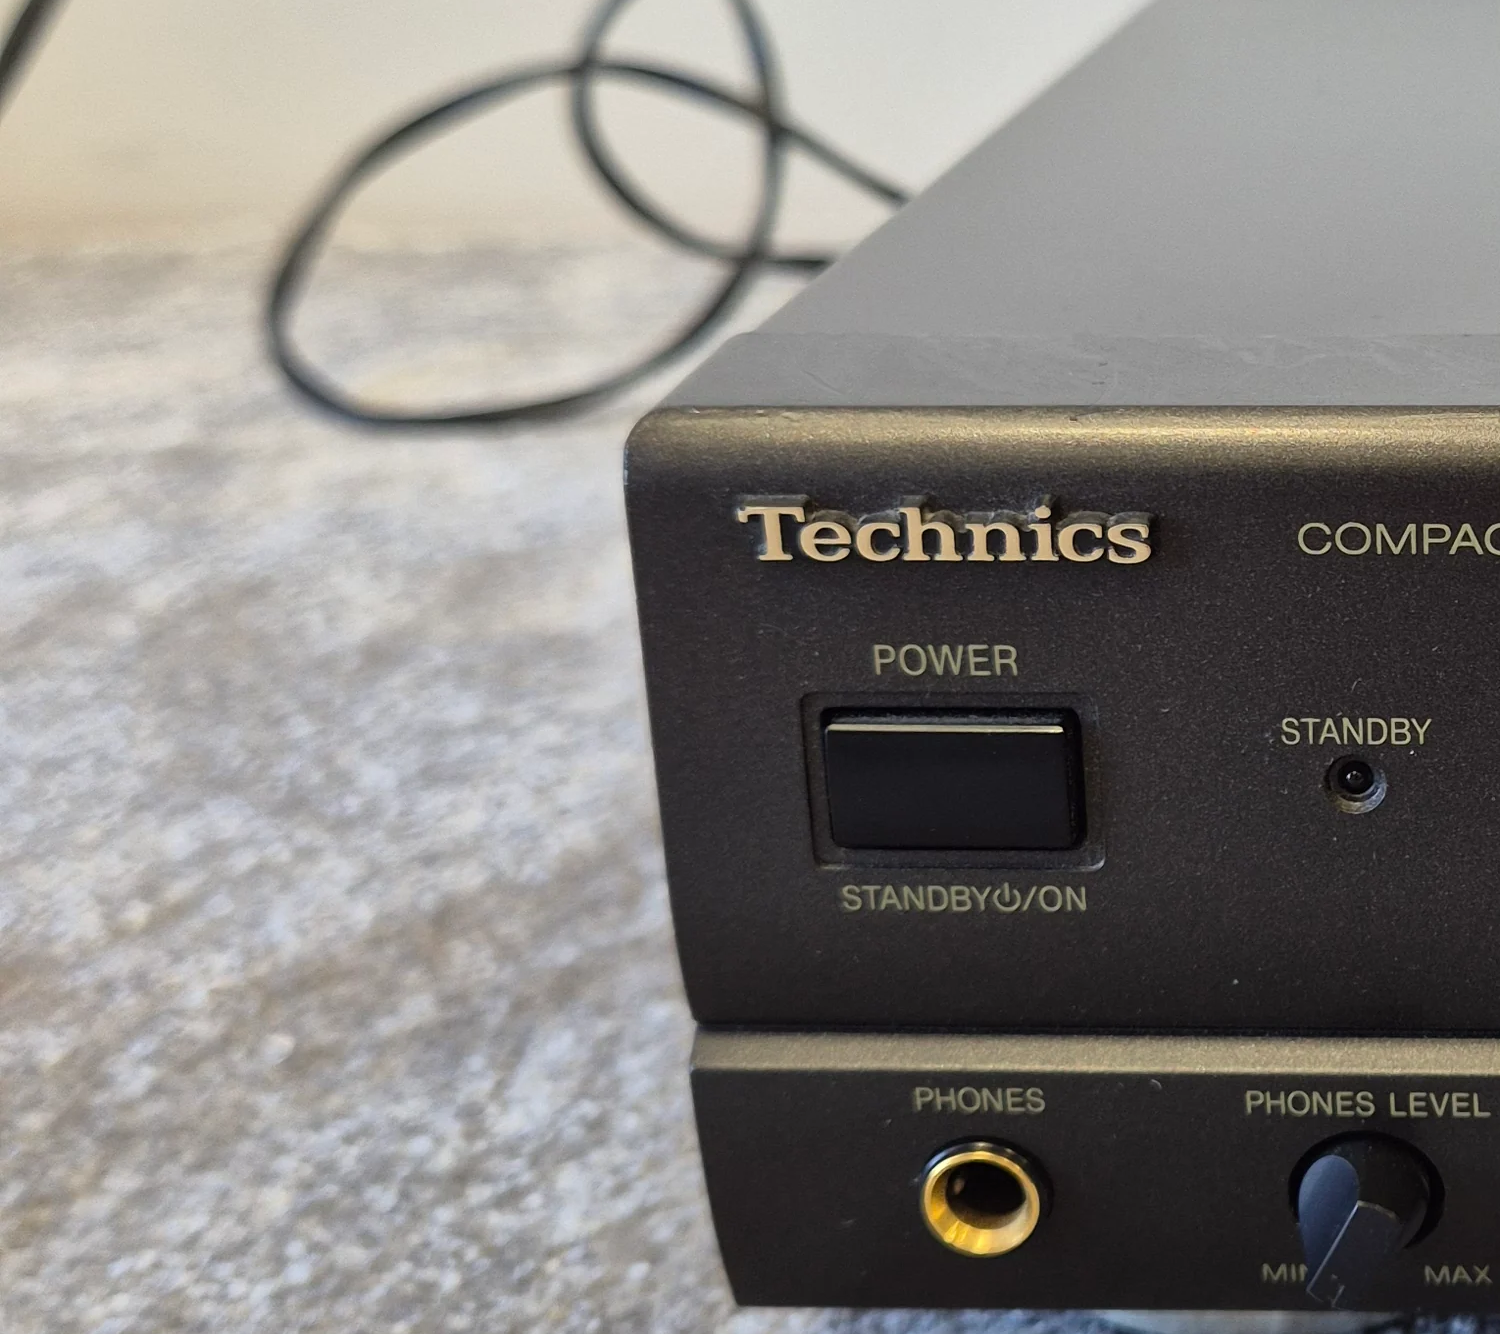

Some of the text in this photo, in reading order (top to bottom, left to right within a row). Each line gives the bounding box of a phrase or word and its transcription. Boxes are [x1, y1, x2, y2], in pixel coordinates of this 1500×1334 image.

[735, 501, 1153, 564] Technics
[872, 643, 1018, 676] POWER
[1281, 717, 1432, 745] STANDBY
[913, 1086, 1046, 1113] PHONES
[1245, 1090, 1491, 1118] PHONES LEVEL
[1424, 1265, 1492, 1285] MAX
